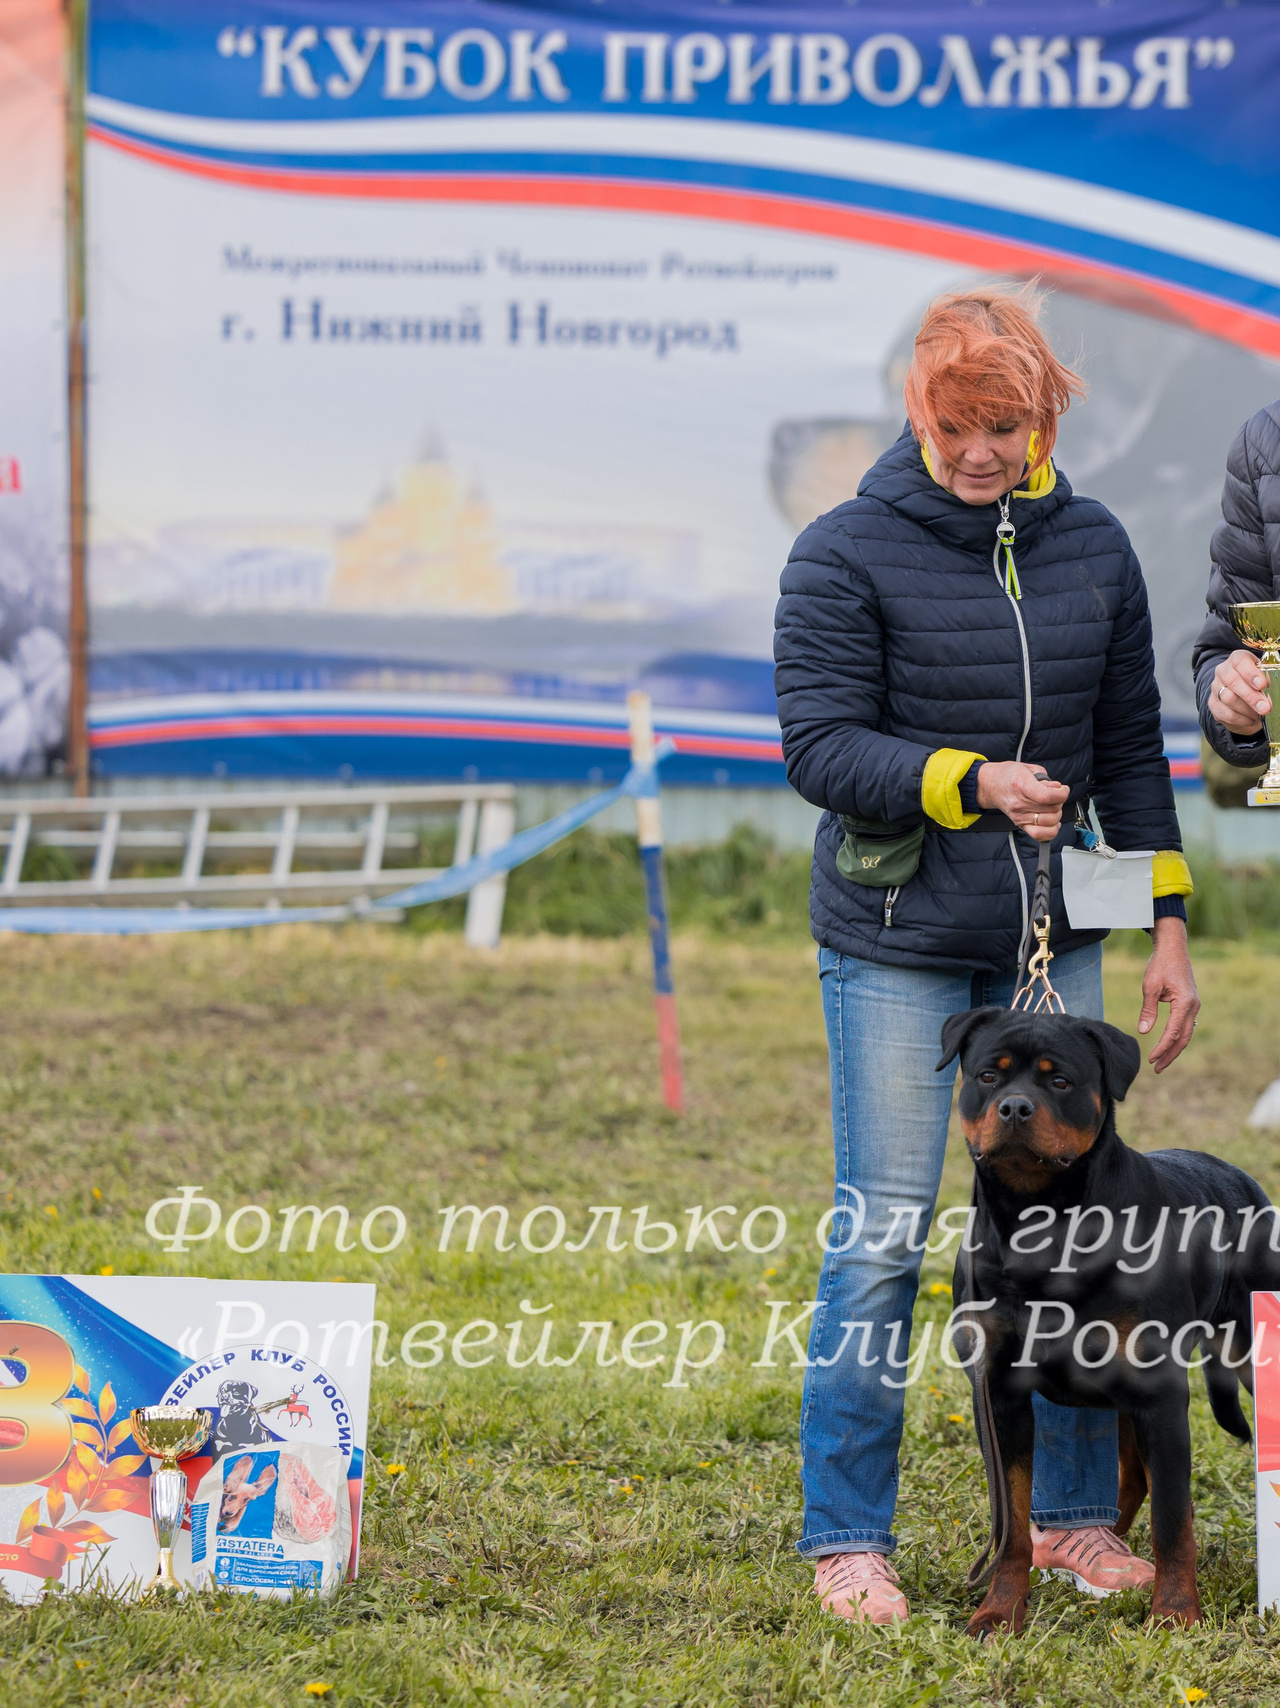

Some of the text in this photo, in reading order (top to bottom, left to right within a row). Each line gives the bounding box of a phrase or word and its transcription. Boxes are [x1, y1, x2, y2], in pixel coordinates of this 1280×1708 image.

[281, 298, 484, 345] Нижний
[508, 300, 742, 358] Новгород
[165, 1352, 236, 1408] ВЕЙЛЕР
[251, 1349, 307, 1373] КЛУБ
